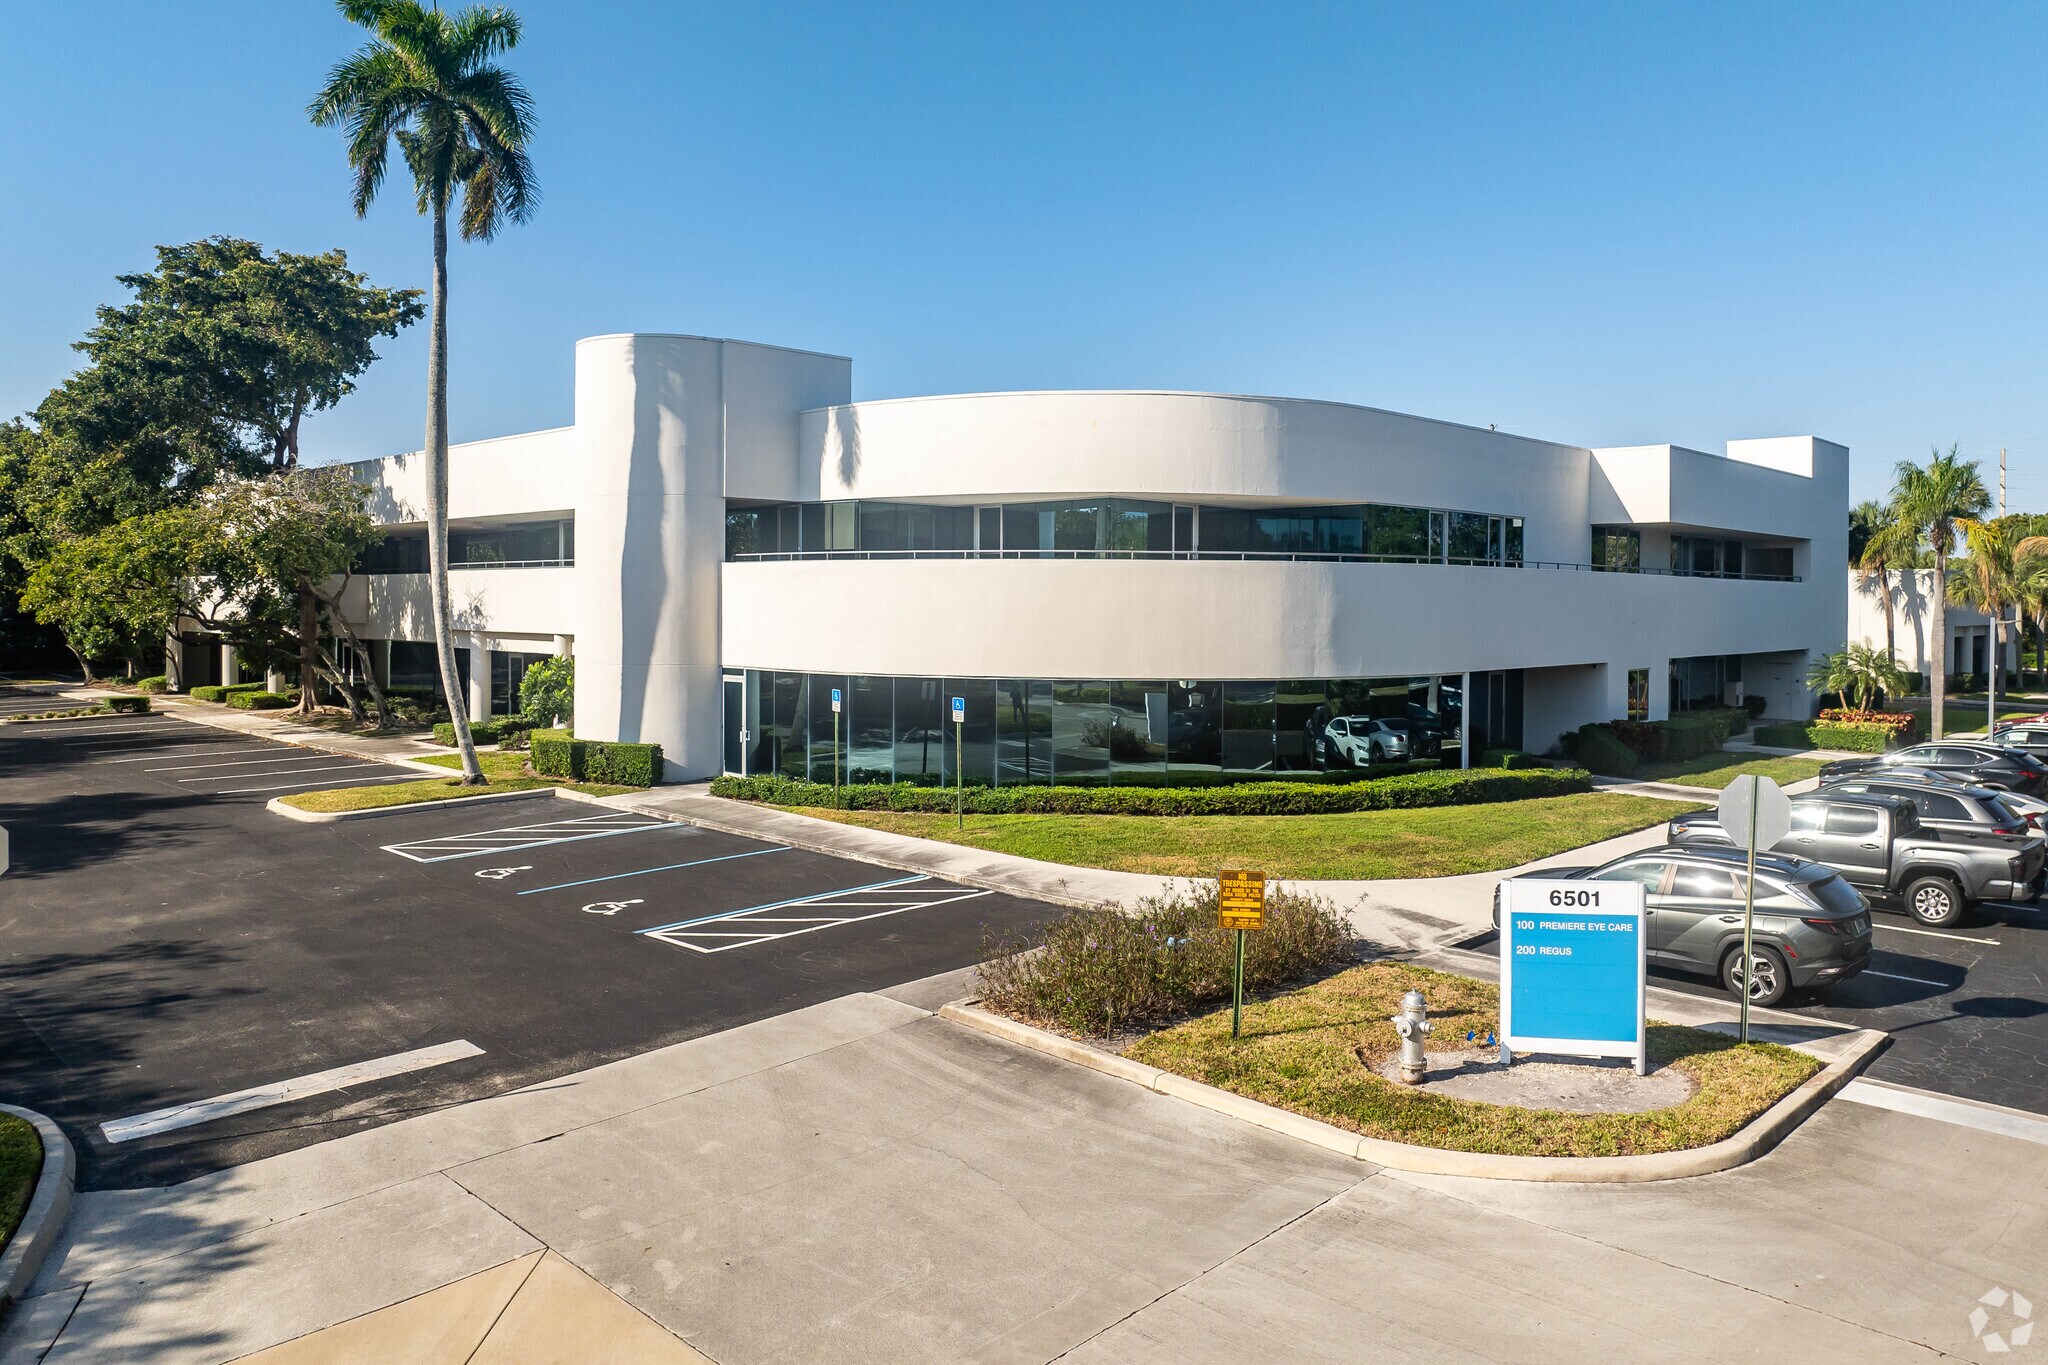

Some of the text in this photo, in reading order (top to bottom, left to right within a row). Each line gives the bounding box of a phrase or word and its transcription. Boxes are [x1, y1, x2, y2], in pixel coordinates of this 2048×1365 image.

[1238, 872, 1247, 880] NO
[1222, 880, 1263, 888] TRESPASSING
[1549, 890, 1600, 907] 6501
[1516, 921, 1633, 932] 100 PREMIERE EYE CARE
[1516, 946, 1572, 956] 200 REGUS
